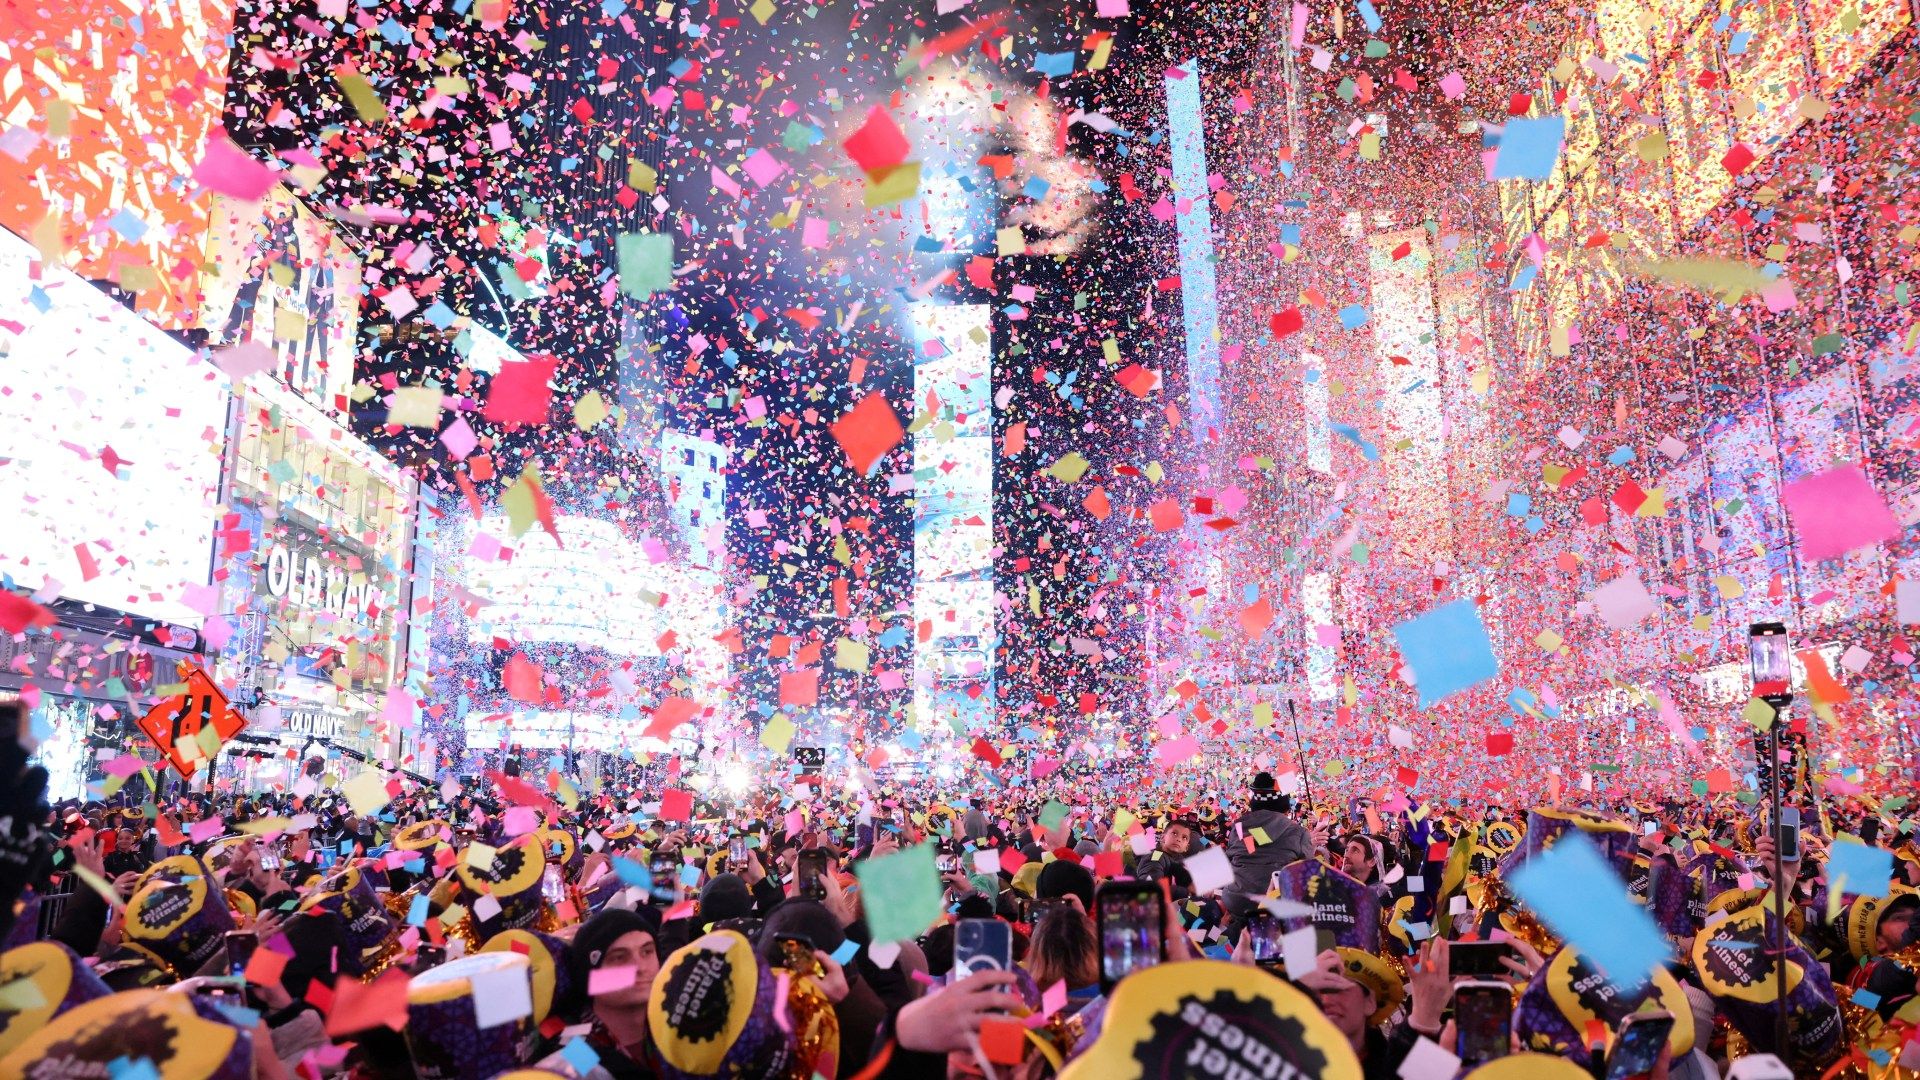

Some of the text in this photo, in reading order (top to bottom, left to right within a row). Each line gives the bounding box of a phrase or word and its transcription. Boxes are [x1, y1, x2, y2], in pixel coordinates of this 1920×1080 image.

[267, 544, 387, 629] OLD NAVY
[290, 711, 342, 738] OLD NAVY
[143, 895, 180, 922] planet
[151, 897, 191, 923] fitness
[350, 906, 376, 931] planet
[1311, 912, 1355, 924] fitness
[1312, 902, 1347, 913] lanet
[670, 958, 711, 1026] fitness
[686, 956, 725, 1018] planet
[1181, 1001, 1313, 1080] itness
[31, 1053, 108, 1079] plan
